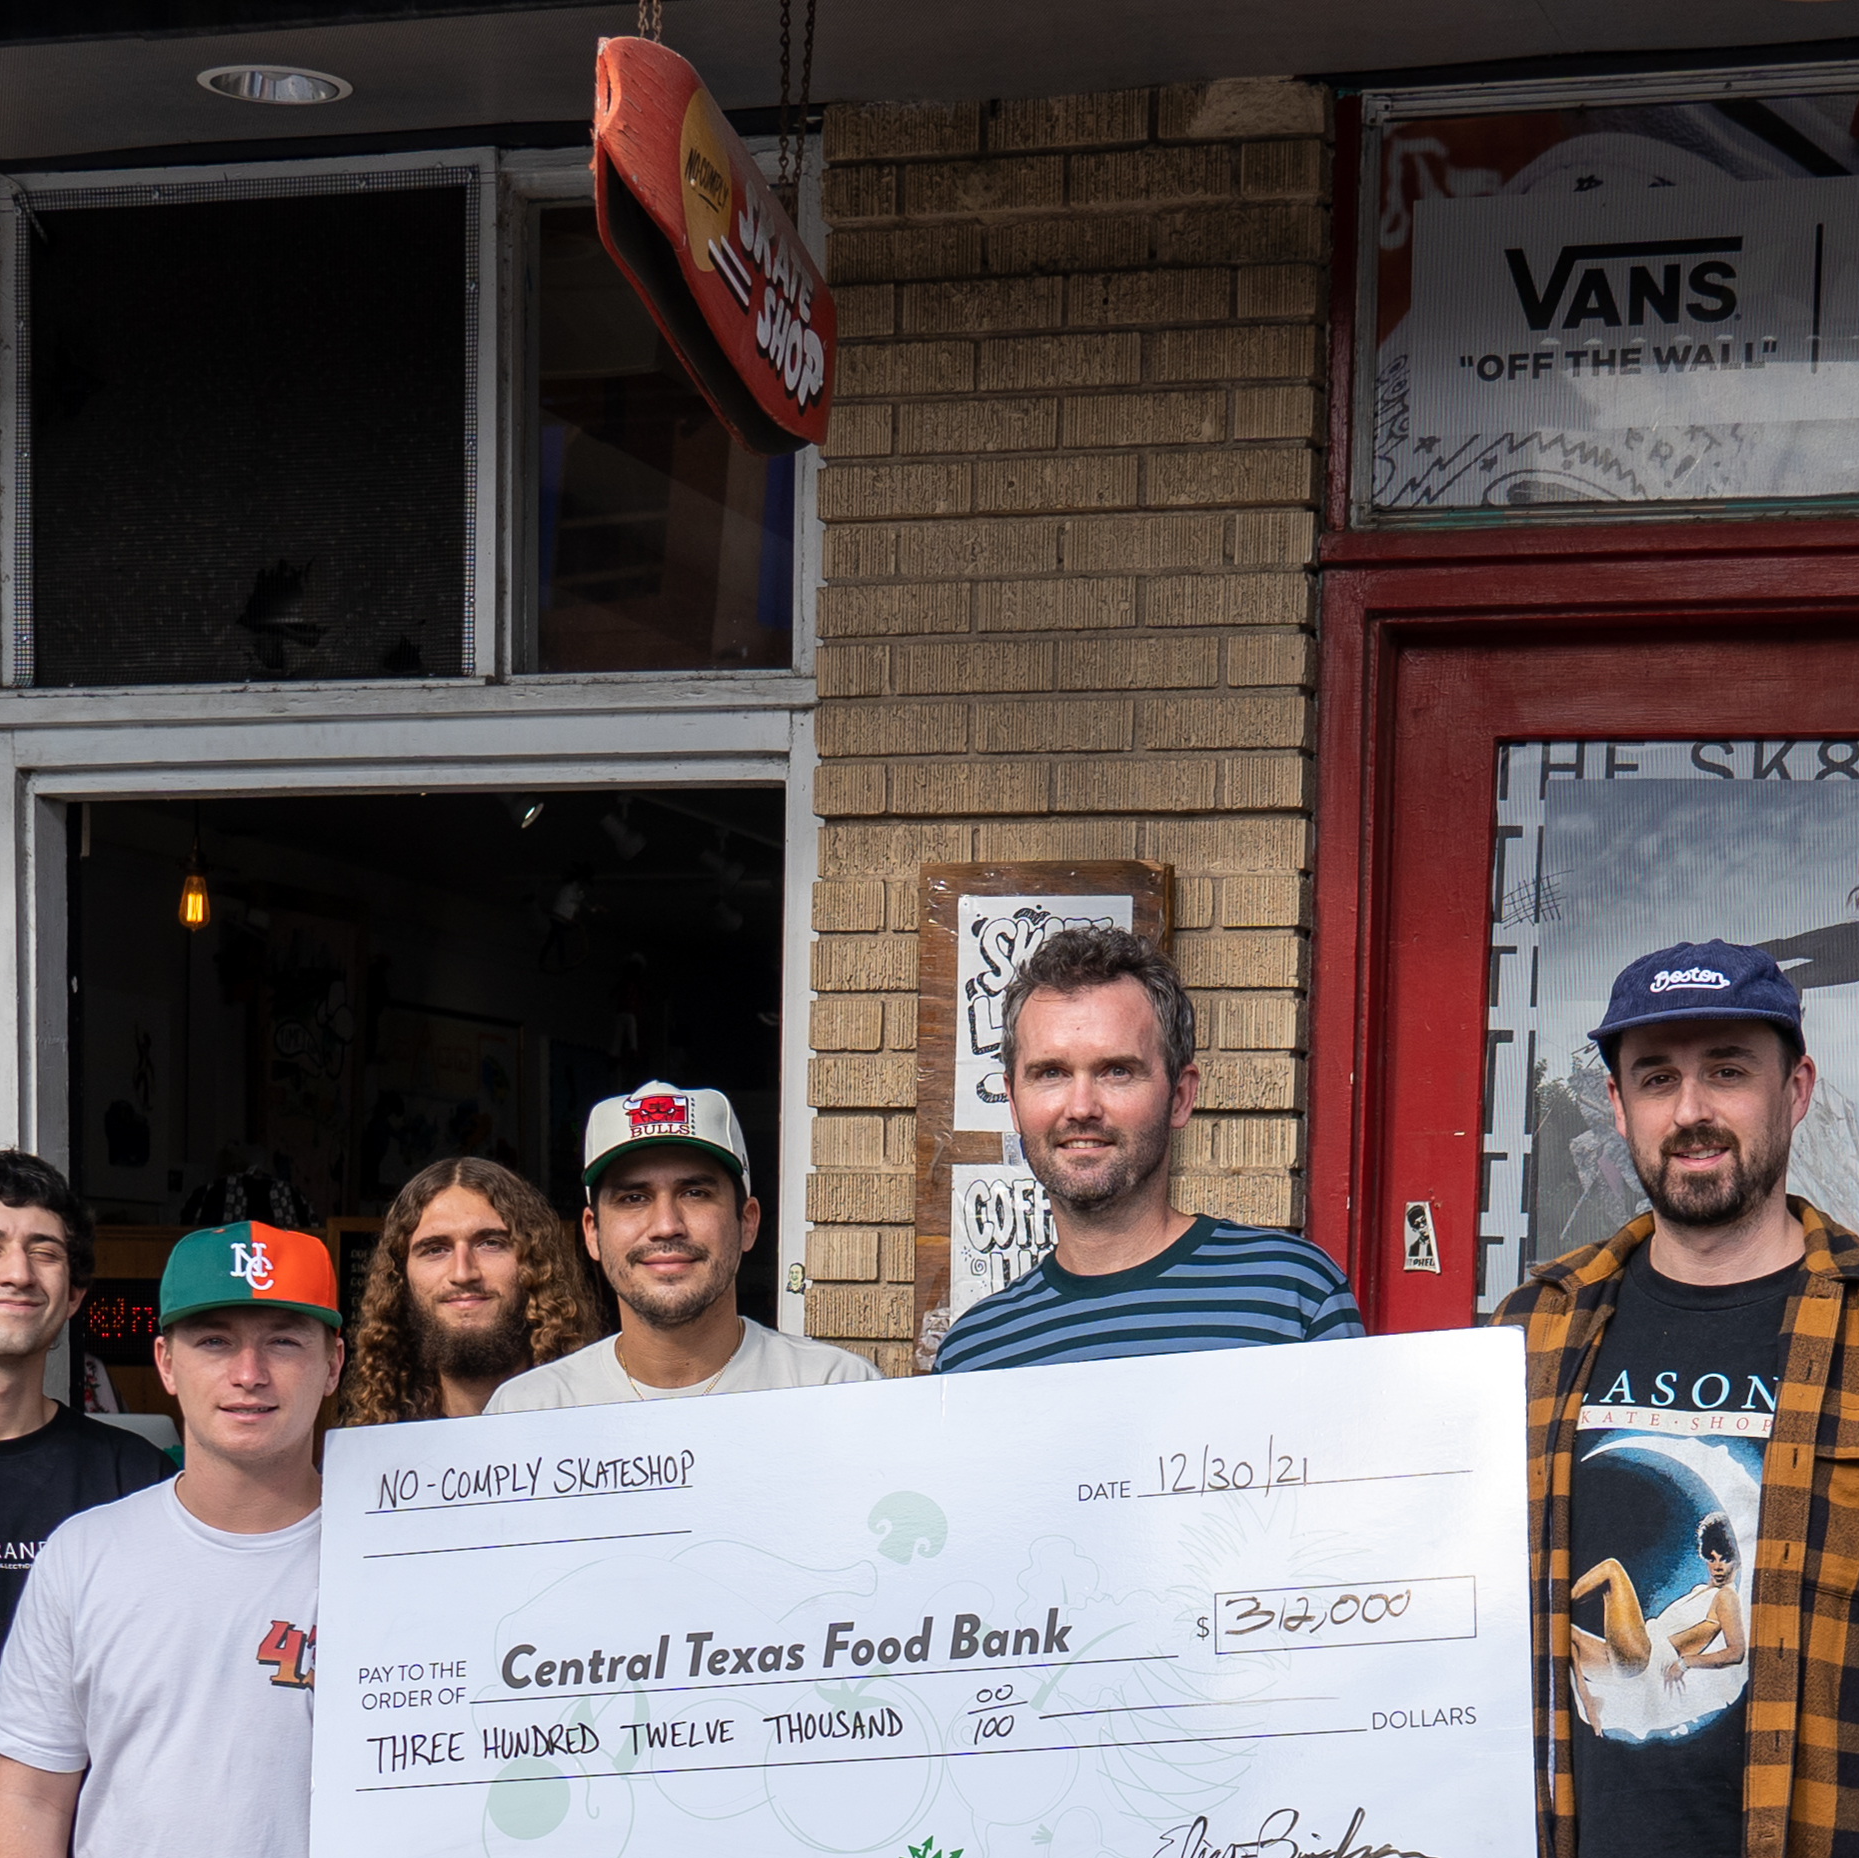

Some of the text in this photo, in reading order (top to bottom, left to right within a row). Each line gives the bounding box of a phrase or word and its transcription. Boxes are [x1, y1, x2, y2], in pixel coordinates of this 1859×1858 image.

[685, 148, 729, 209] NO-COMPLY
[738, 180, 814, 324] SKATE
[1505, 236, 1744, 334] VANS
[756, 287, 825, 407] SHOP
[1458, 351, 1553, 385] "OFF
[1566, 348, 1642, 378] THE
[1649, 967, 1731, 993] Boston
[630, 1125, 691, 1139] BULLS
[963, 1176, 1059, 1253] COFF
[1582, 1369, 1779, 1413] ASON
[378, 1449, 696, 1510] NO-COMPLY SKATESHOP
[1078, 1480, 1132, 1502] DATE
[501, 1607, 1073, 1691] Central Texas Food Bank
[1196, 1614, 1211, 1643] $
[358, 1659, 467, 1686] PAY TO THE
[361, 1686, 467, 1711] ORDER OF
[1371, 1705, 1478, 1732] DOLLARS
[366, 1706, 904, 1774] THREE HUNDRED TWELVE THOUSAND
